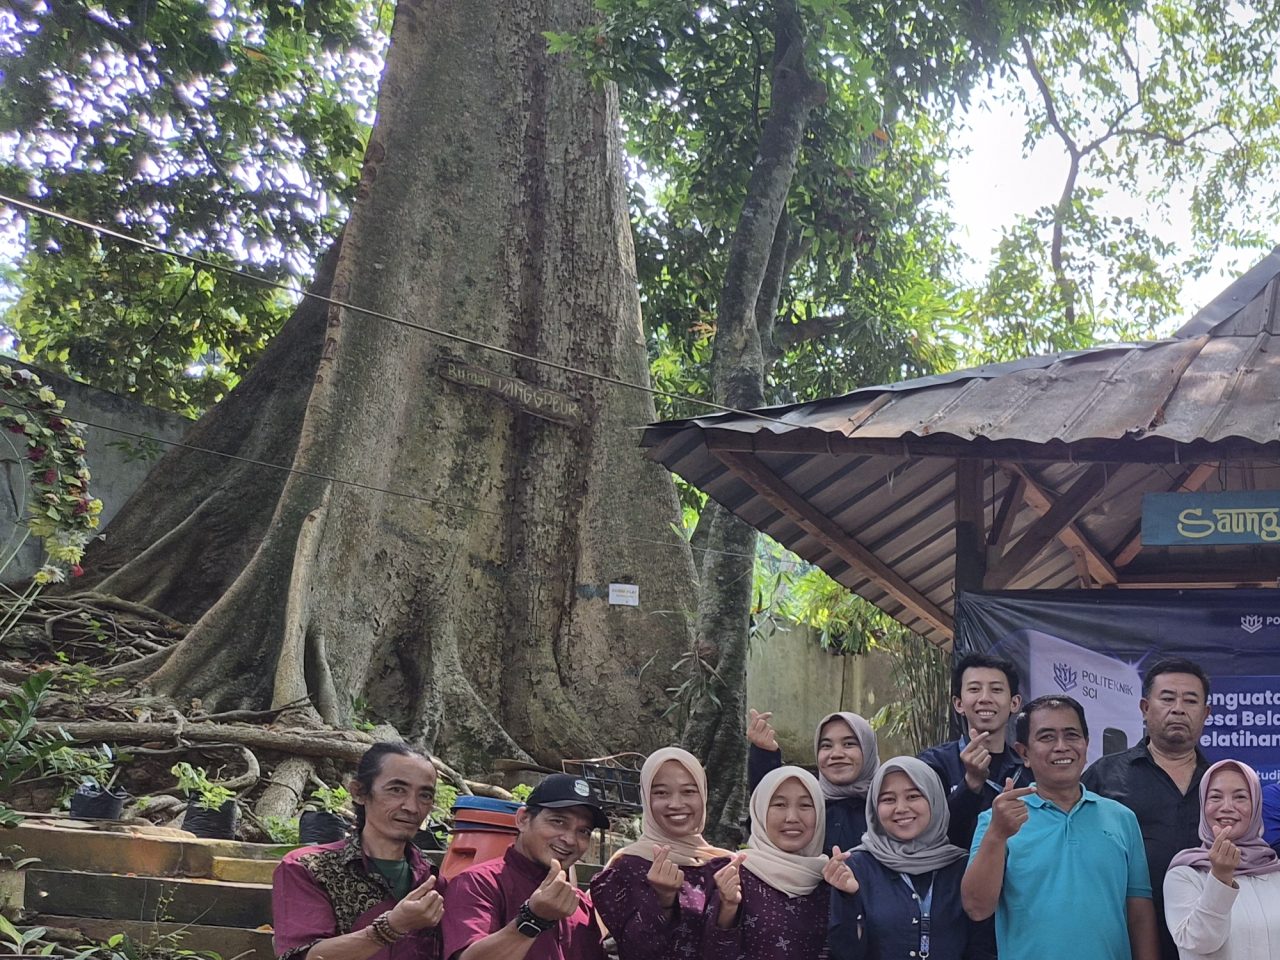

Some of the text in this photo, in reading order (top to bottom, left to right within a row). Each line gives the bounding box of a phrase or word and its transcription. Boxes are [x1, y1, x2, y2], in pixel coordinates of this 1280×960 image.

[1082, 670, 1133, 696] POLITEKNIK
[1082, 686, 1098, 699] SCI
[1204, 713, 1238, 726] esa
